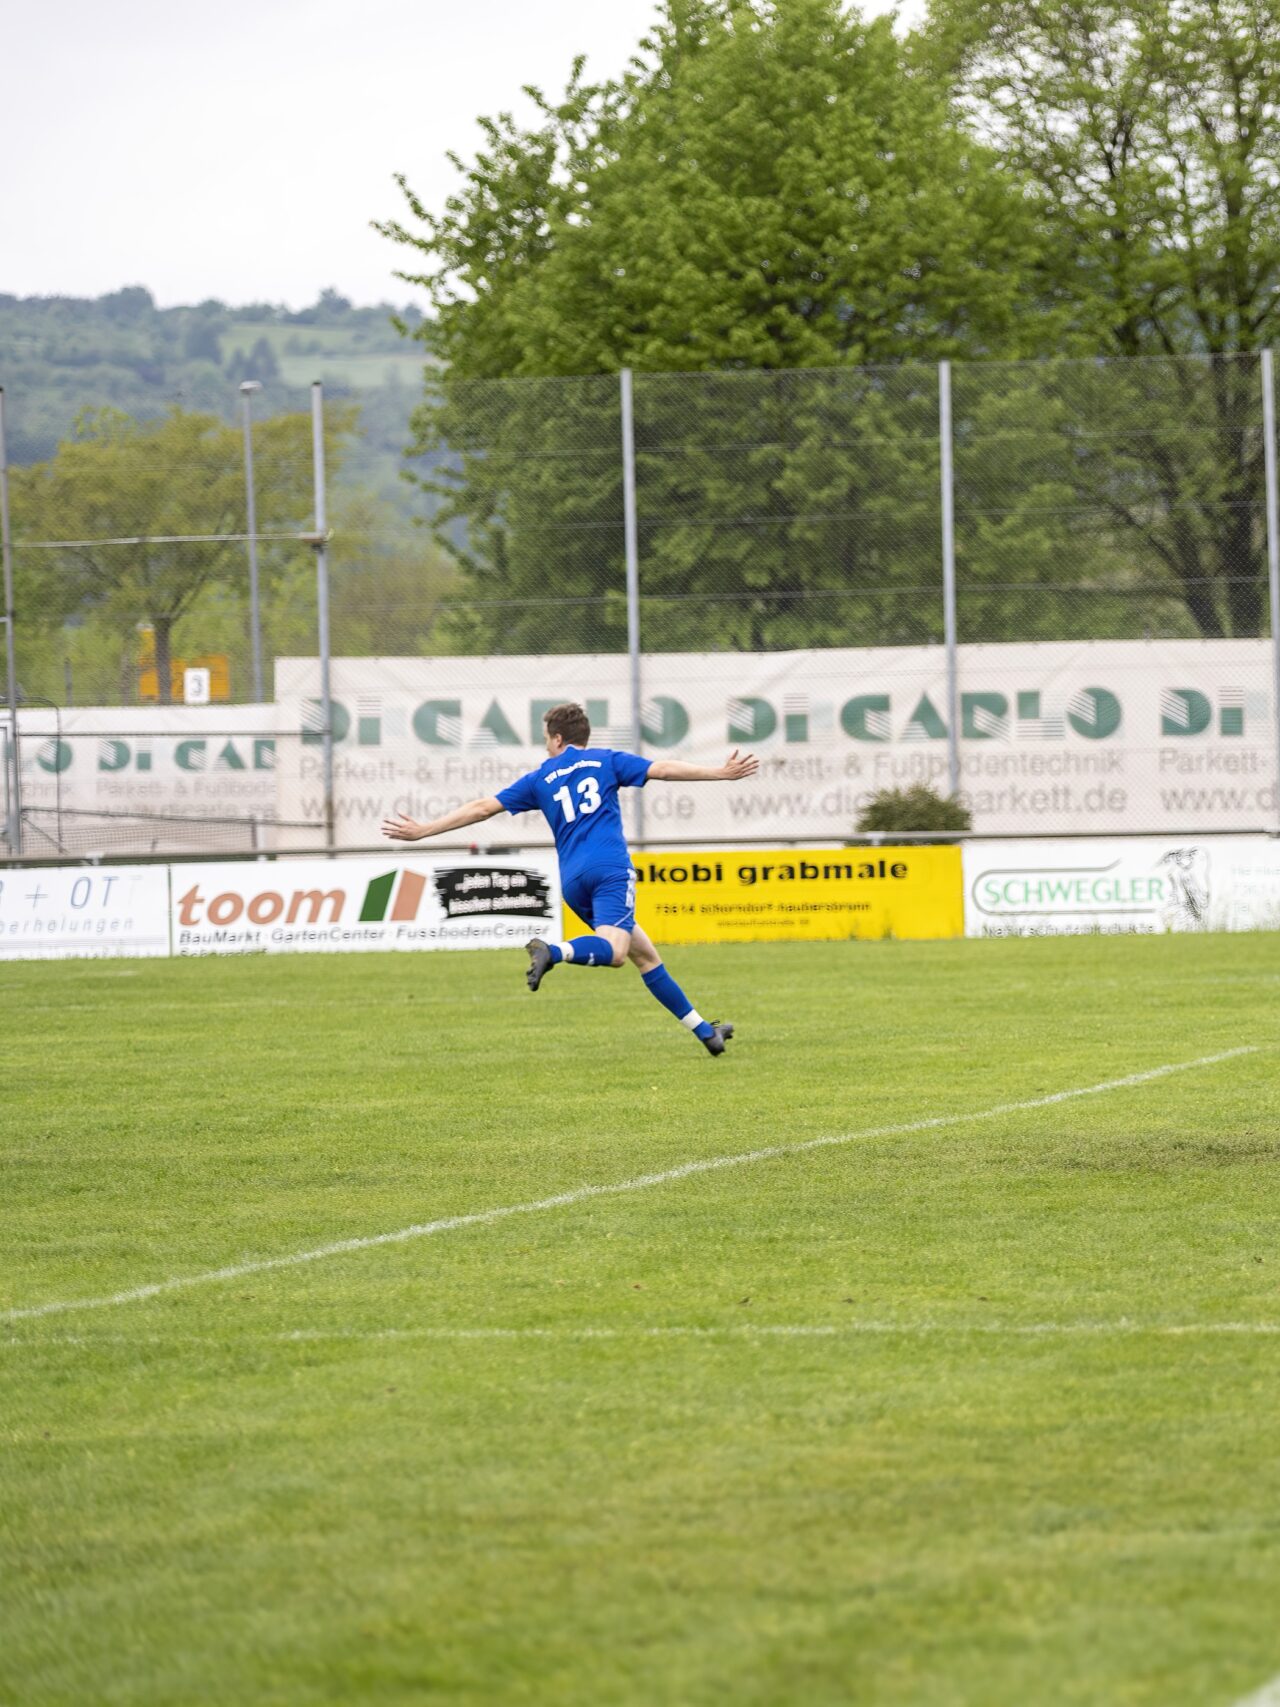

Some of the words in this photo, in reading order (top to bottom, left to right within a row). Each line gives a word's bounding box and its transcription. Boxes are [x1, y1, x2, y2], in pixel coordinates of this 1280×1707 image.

[553, 776, 602, 823] 13
[633, 863, 723, 884] akobi
[738, 859, 908, 885] grabmale
[178, 884, 347, 926] toom
[984, 877, 1166, 905] SCHWEGLER
